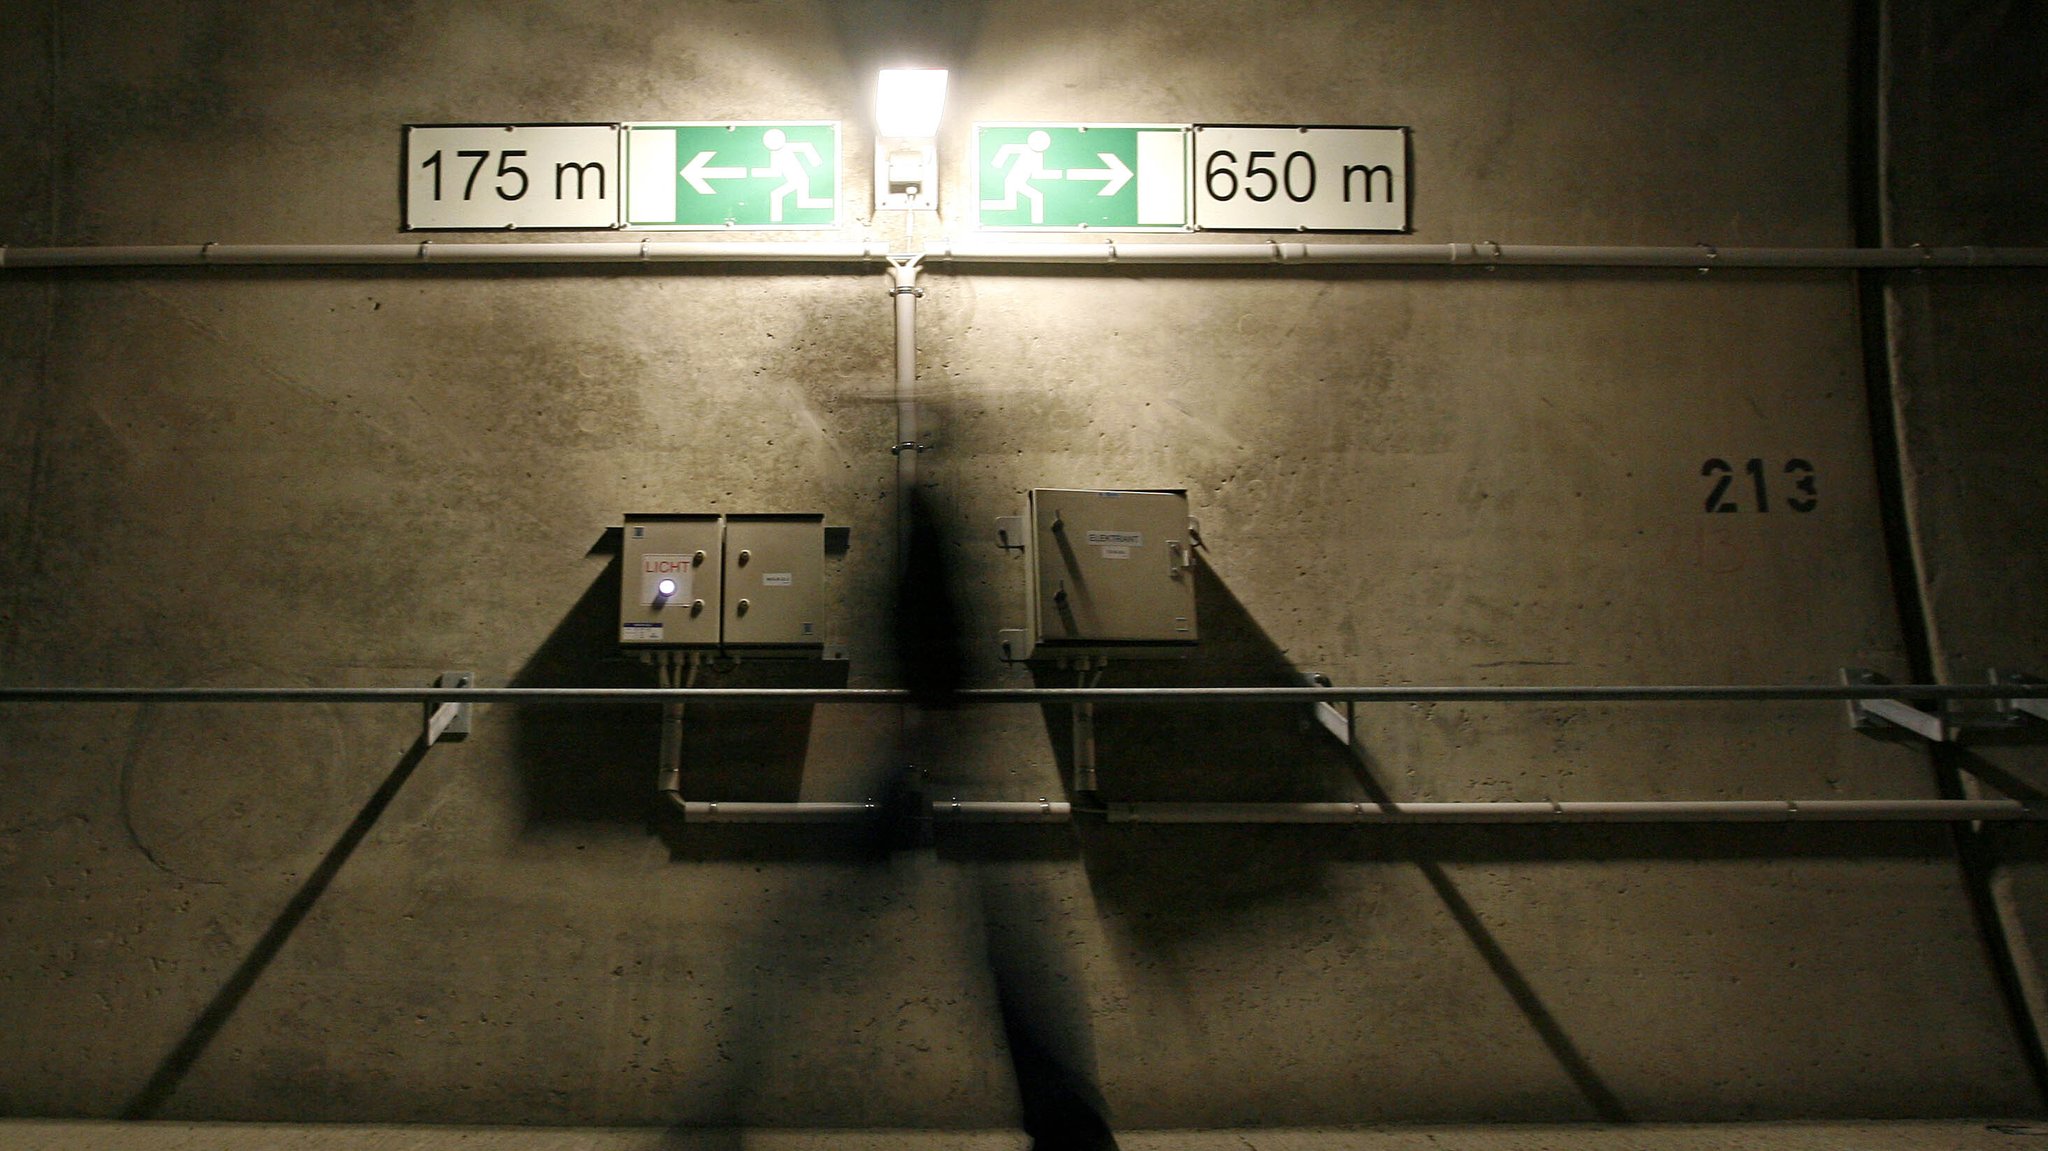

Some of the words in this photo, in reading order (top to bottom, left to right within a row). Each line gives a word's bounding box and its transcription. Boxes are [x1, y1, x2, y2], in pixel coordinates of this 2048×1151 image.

[421, 150, 529, 201] 175
[555, 160, 606, 200] m
[1205, 150, 1317, 203] 650
[1343, 163, 1395, 203] m
[1702, 458, 1818, 513] 213
[645, 561, 690, 573] LICHT
